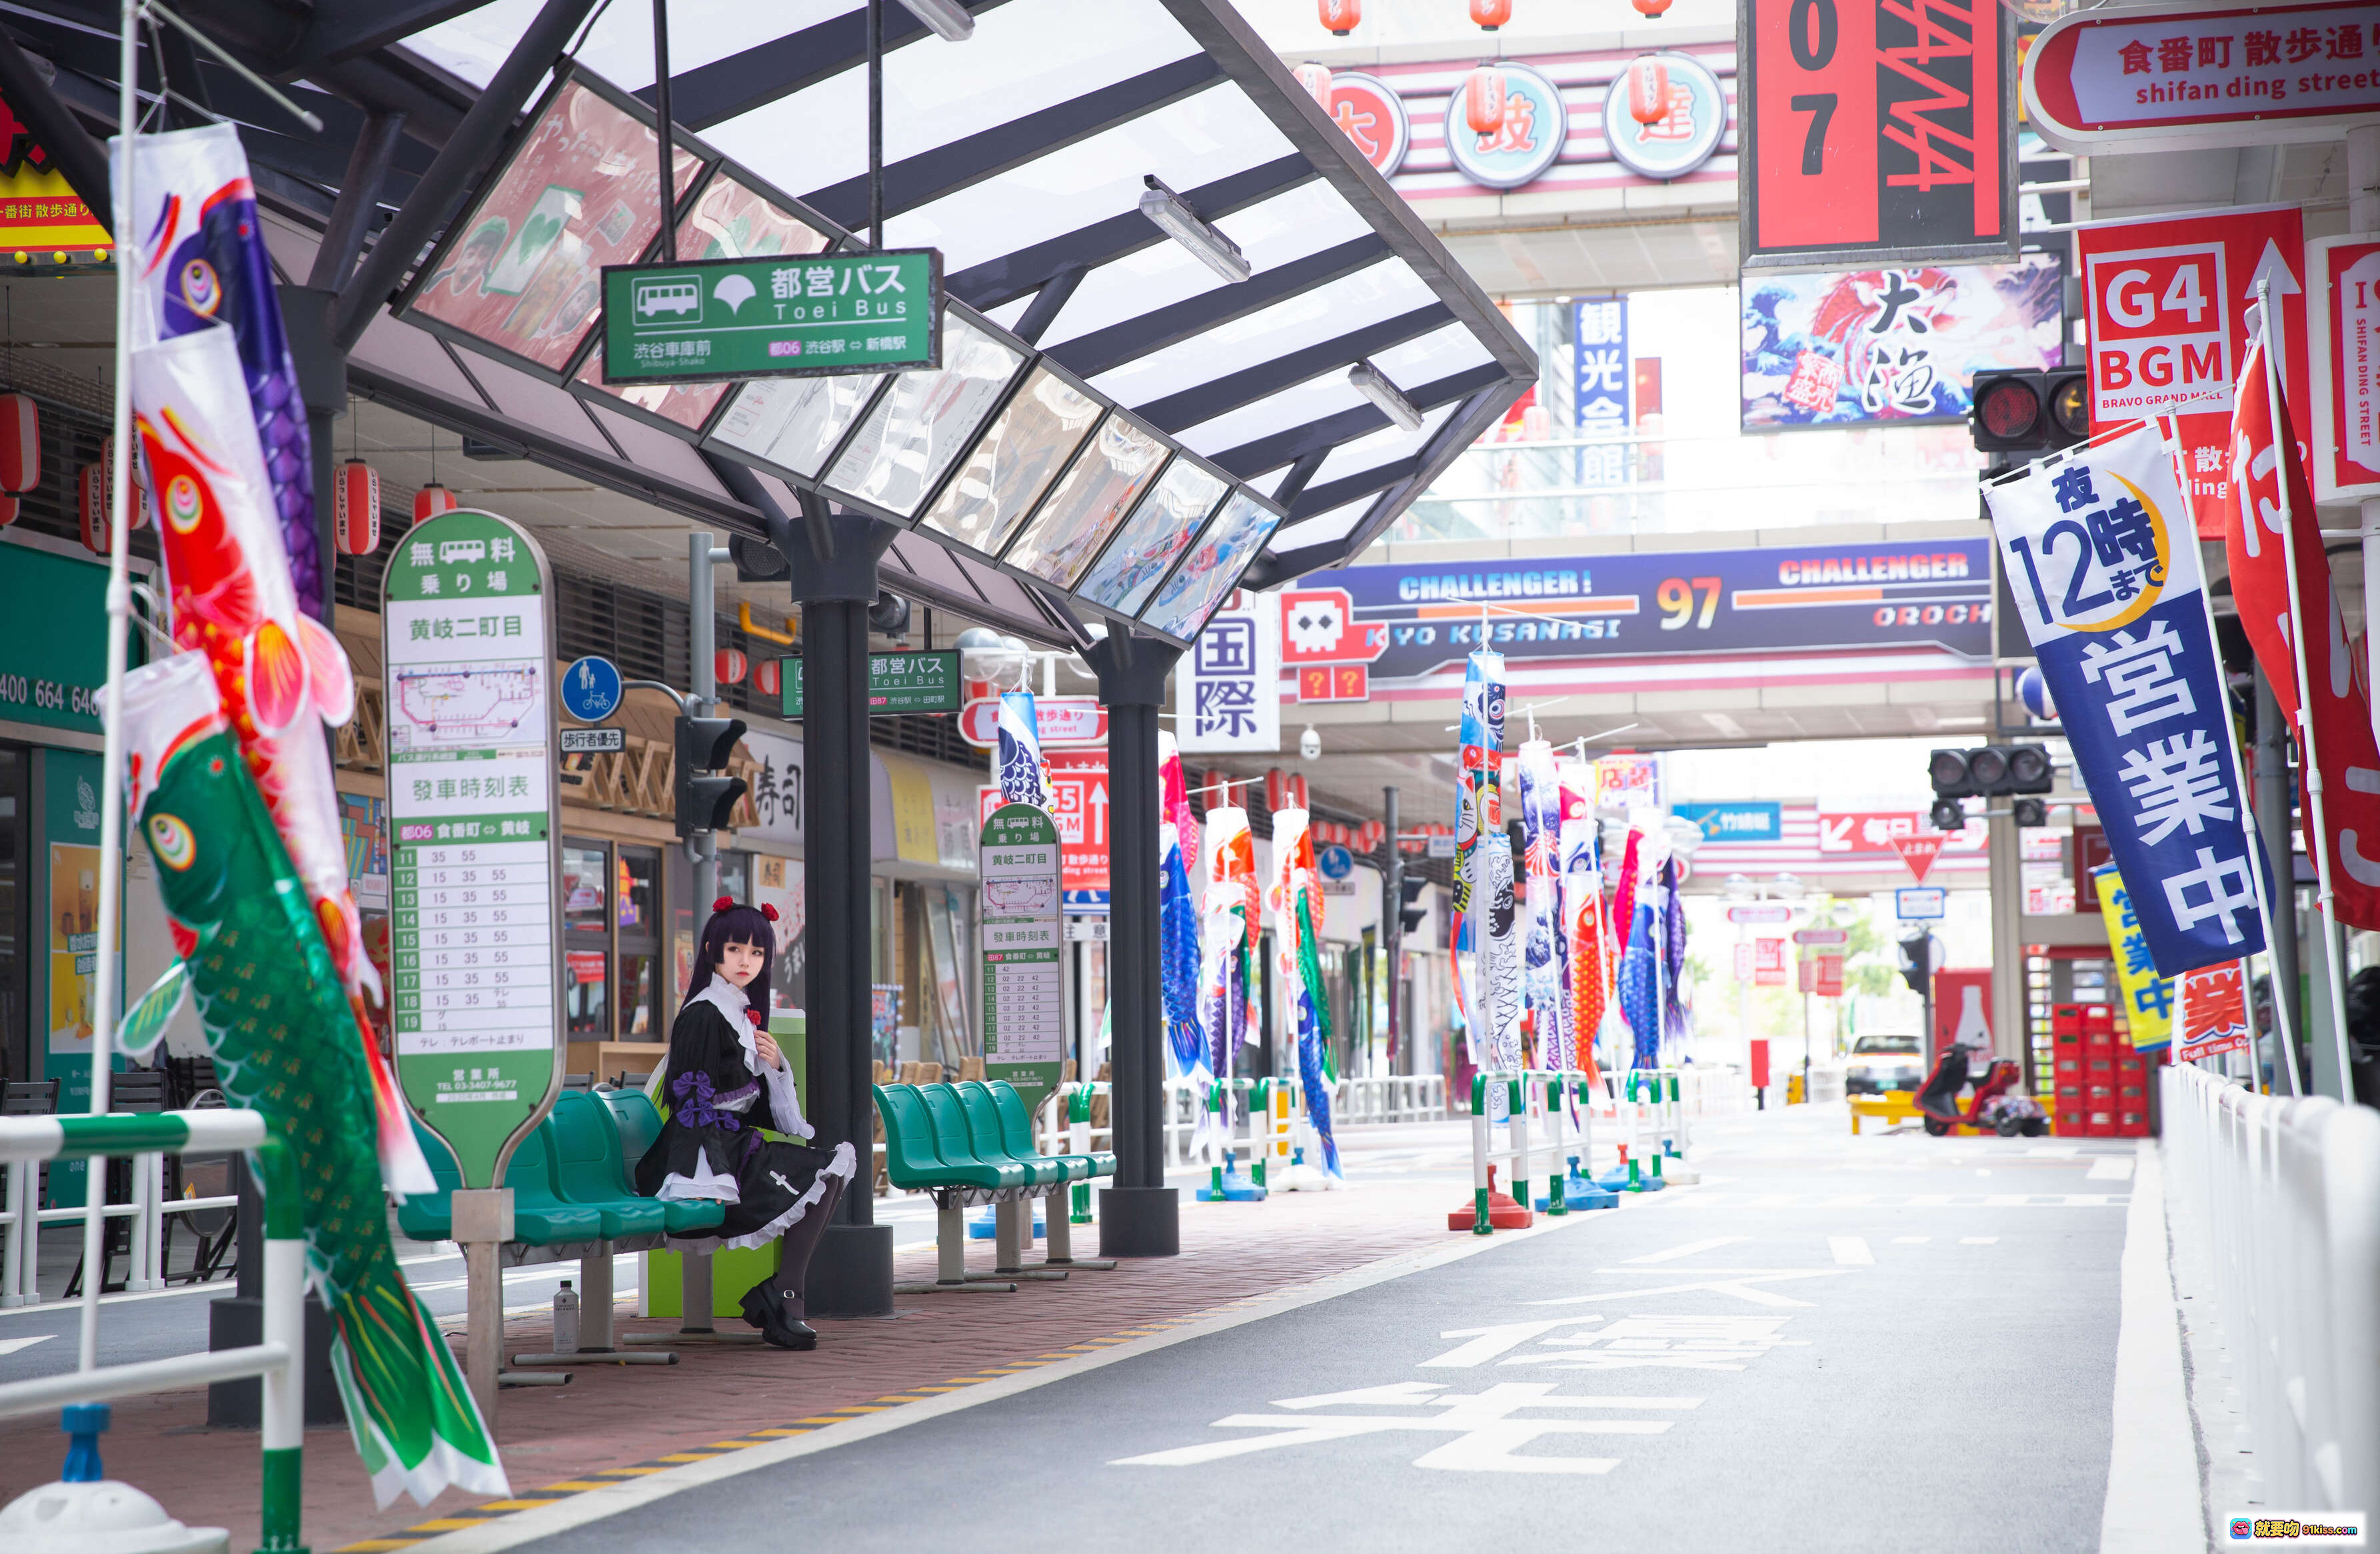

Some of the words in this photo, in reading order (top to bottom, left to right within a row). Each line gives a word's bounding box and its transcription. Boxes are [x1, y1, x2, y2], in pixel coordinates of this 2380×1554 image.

[2117, 35, 2234, 75] 食番町
[2298, 69, 2380, 93] street
[0, 204, 32, 219] 番街
[771, 265, 906, 299] 都営バス
[2106, 263, 2207, 328] G4
[774, 301, 836, 320] Toei
[856, 298, 906, 316] Bus
[634, 340, 711, 360] 渋谷車庫前
[770, 341, 800, 356] 都06
[805, 339, 844, 355] 渋谷駅
[866, 336, 906, 351] 新橋駅
[2099, 341, 2223, 392] BGM
[2102, 396, 2142, 409] BRAVO
[2359, 400, 2371, 446] STREET
[2051, 466, 2099, 513] 夜
[422, 571, 507, 595] 乗り場
[1779, 553, 1969, 585] CHALLENGER
[1657, 576, 1722, 630] 97
[871, 657, 944, 675] 都営バス
[872, 677, 906, 686] Toei
[917, 676, 944, 684] Bus
[1195, 617, 1257, 738] 国際
[35, 679, 64, 711] 664
[564, 732, 619, 747] 歩行者優先
[756, 755, 802, 831] 寿司
[2080, 619, 2259, 945] 営業中
